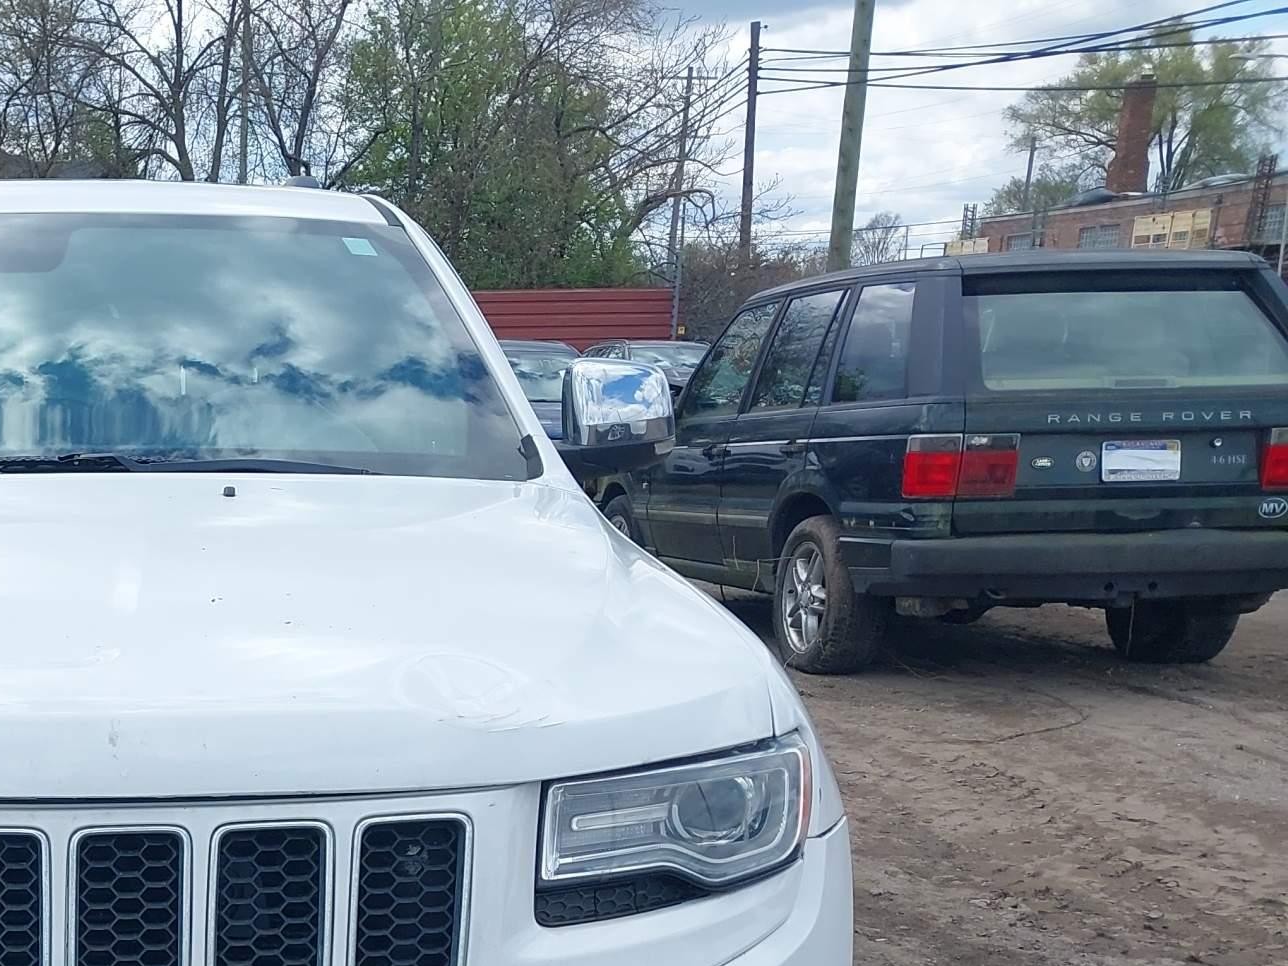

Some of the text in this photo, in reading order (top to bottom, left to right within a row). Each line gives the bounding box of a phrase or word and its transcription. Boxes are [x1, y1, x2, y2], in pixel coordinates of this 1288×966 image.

[1047, 410, 1252, 424] RANGE ROVER
[1261, 502, 1285, 513] MV
